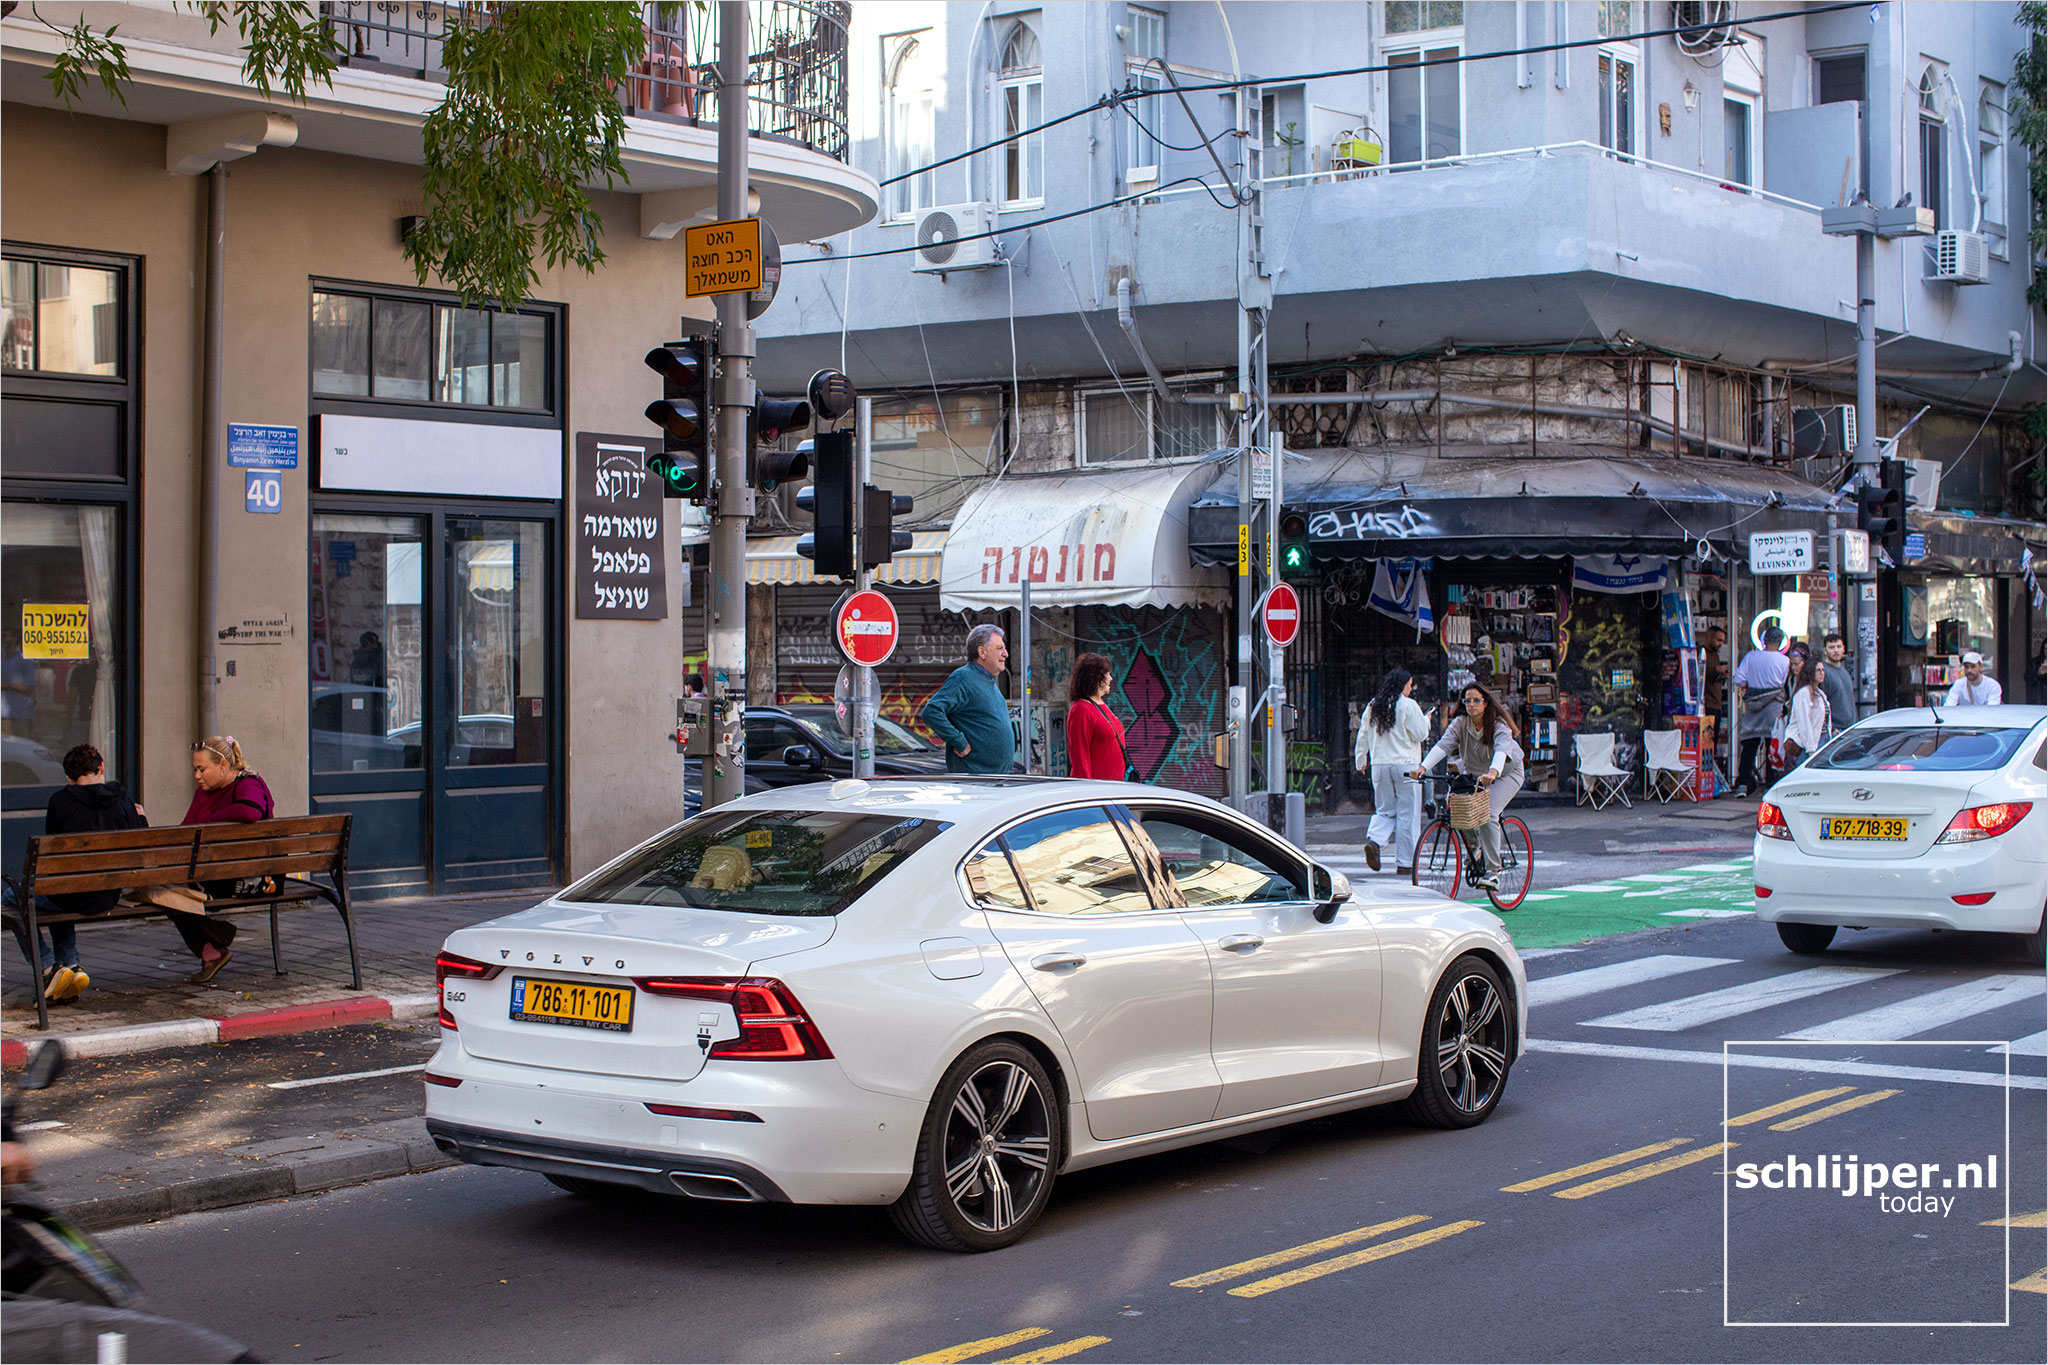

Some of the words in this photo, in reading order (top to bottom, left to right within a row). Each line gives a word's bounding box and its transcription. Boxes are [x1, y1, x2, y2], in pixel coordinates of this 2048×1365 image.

[706, 231, 734, 246] האט
[692, 253, 719, 269] חוצה
[694, 269, 751, 291] משמאלך
[334, 447, 348, 456] כשר
[246, 479, 280, 507] 40
[596, 467, 646, 504] ינוקא
[583, 513, 657, 540] שוארמה
[1240, 527, 1248, 563] 463
[1754, 535, 1784, 548] לוינסקי
[592, 545, 651, 575] פלאפל
[981, 543, 1116, 585] מונטנה
[1756, 559, 1797, 570] LEVINSKY
[594, 581, 650, 610] שניצל
[24, 610, 88, 627] להשכרה
[24, 630, 88, 644] 050-9551521
[500, 949, 626, 970] VOLVO
[446, 991, 466, 1003] S60
[586, 1020, 600, 1029] MY
[602, 1021, 622, 1032] CAR
